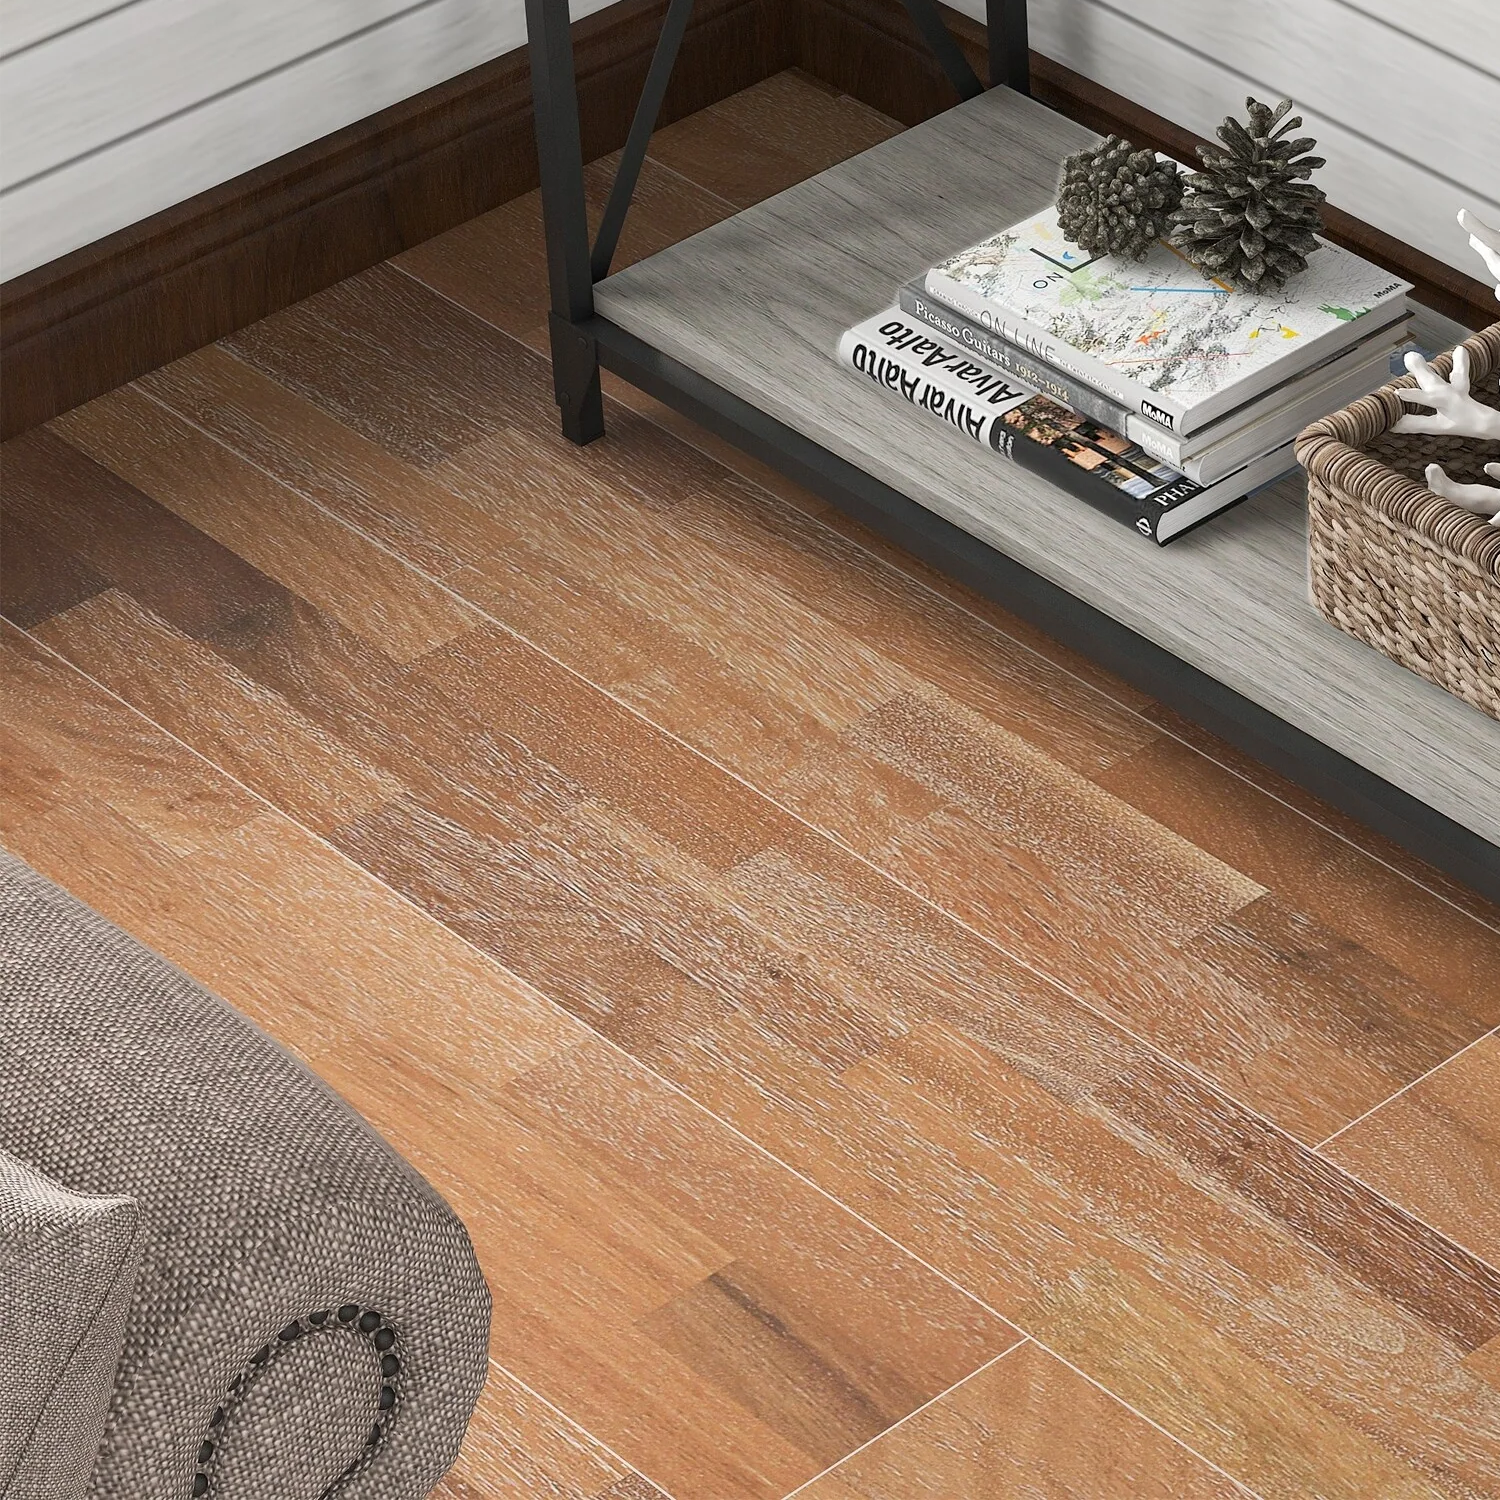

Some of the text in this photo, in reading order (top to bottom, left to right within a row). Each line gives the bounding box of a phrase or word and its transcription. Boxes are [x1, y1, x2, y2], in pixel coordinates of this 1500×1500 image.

[1033, 272, 1064, 289] ON
[1373, 282, 1402, 299] MoMA
[878, 321, 958, 367] Aalto
[914, 300, 961, 338] Picasso
[961, 327, 1011, 367] Guitars
[980, 310, 1056, 363] ON LINE
[852, 343, 921, 405] Aalto
[942, 360, 1025, 405] Alvar
[920, 383, 987, 444] Alvar
[1142, 401, 1172, 429] MoMA
[1142, 433, 1174, 460] MoMA
[1153, 479, 1200, 507] PHAI
